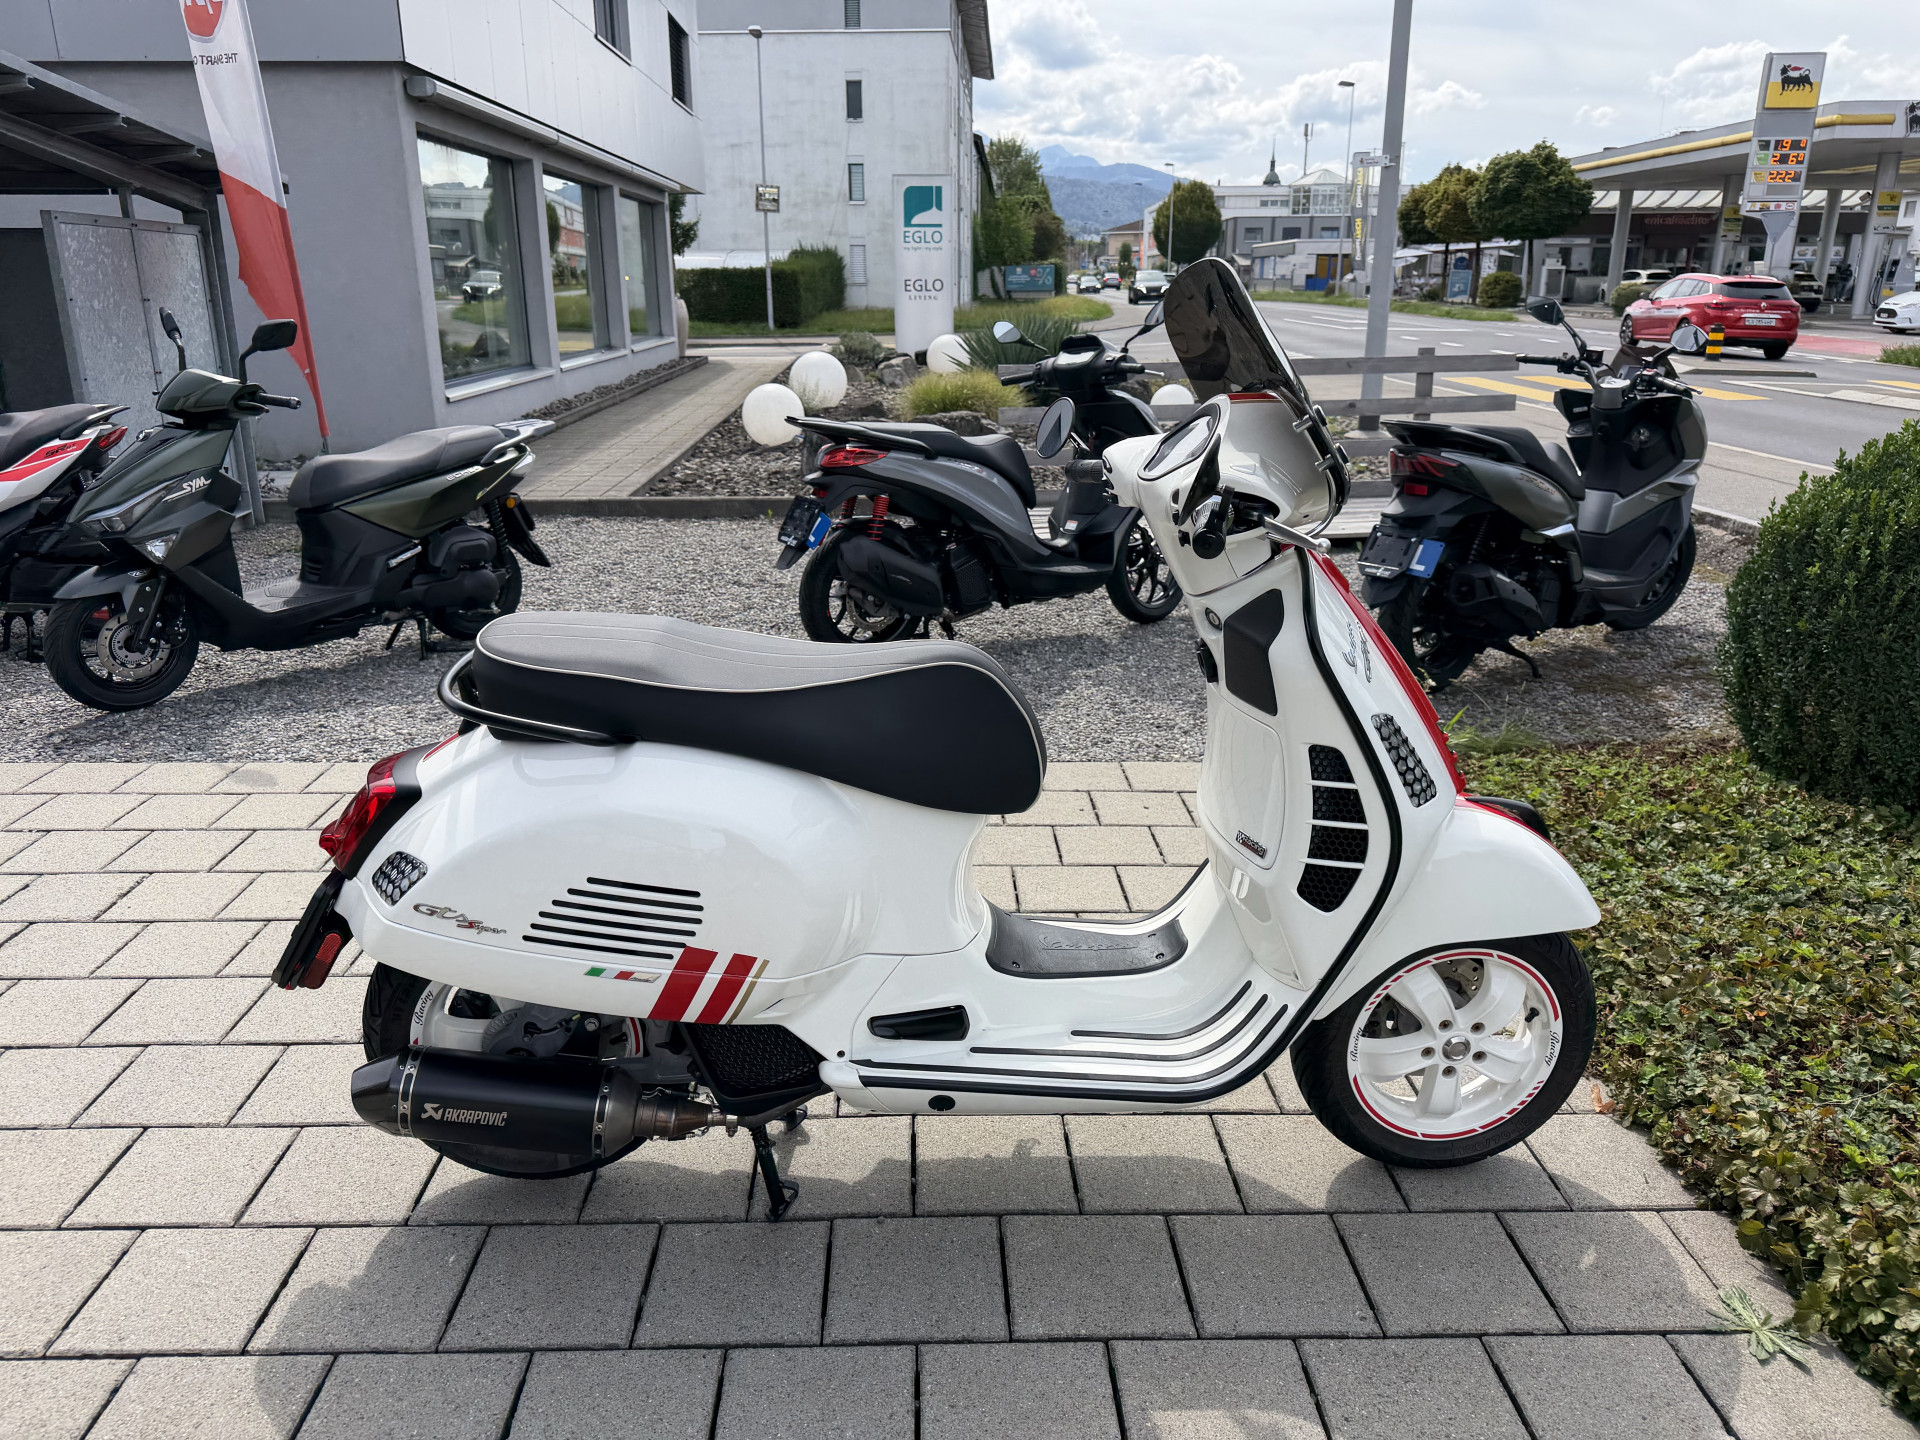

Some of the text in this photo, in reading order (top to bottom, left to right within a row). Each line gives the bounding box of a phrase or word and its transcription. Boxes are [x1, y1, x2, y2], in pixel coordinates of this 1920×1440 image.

[903, 230, 943, 244] EGLO
[904, 278, 944, 293] EGLO
[162, 475, 213, 502] SYM
[1409, 544, 1427, 572] L
[456, 919, 508, 935] Super
[412, 988, 434, 1026] Racing
[1350, 1026, 1364, 1062] Racing
[1544, 1030, 1561, 1068] Racing
